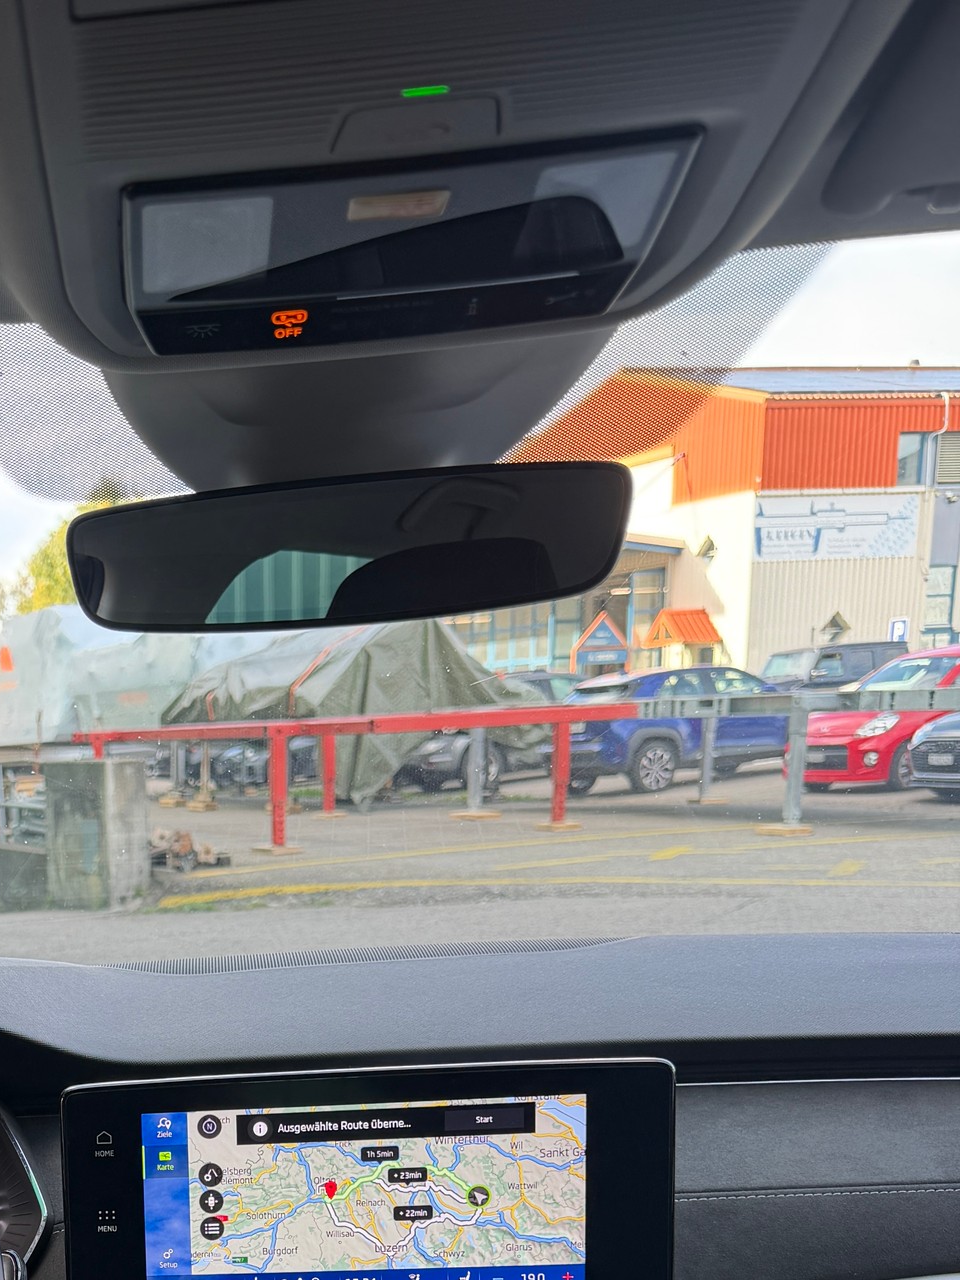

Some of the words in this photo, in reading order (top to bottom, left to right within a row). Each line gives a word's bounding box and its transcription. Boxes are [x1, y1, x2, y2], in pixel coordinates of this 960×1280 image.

[274, 327, 303, 339] OFF
[475, 1115, 493, 1123] Start
[278, 1121, 339, 1135] Ausgewählte
[341, 1119, 369, 1130] Route
[157, 1131, 173, 1139] Ziele
[510, 1141, 523, 1150] Wil
[95, 1150, 114, 1158] HOME
[366, 1150, 375, 1158] 1h
[376, 1150, 394, 1158] 5min
[540, 1148, 569, 1159] Sankt
[157, 1163, 175, 1171] Karte
[221, 1166, 252, 1176] elsberg
[399, 1171, 422, 1180] 23min
[508, 1182, 538, 1190] Wattwil
[355, 1199, 386, 1207] Reinach
[246, 1212, 286, 1220] Solothurn
[404, 1209, 428, 1218] 22min
[326, 1230, 355, 1238] Willisau
[262, 1246, 298, 1256] Burgdorf
[374, 1243, 408, 1253] Luzern
[505, 1243, 533, 1252] Glarus
[433, 1249, 465, 1259] Schwyz
[159, 1261, 178, 1269] Setup
